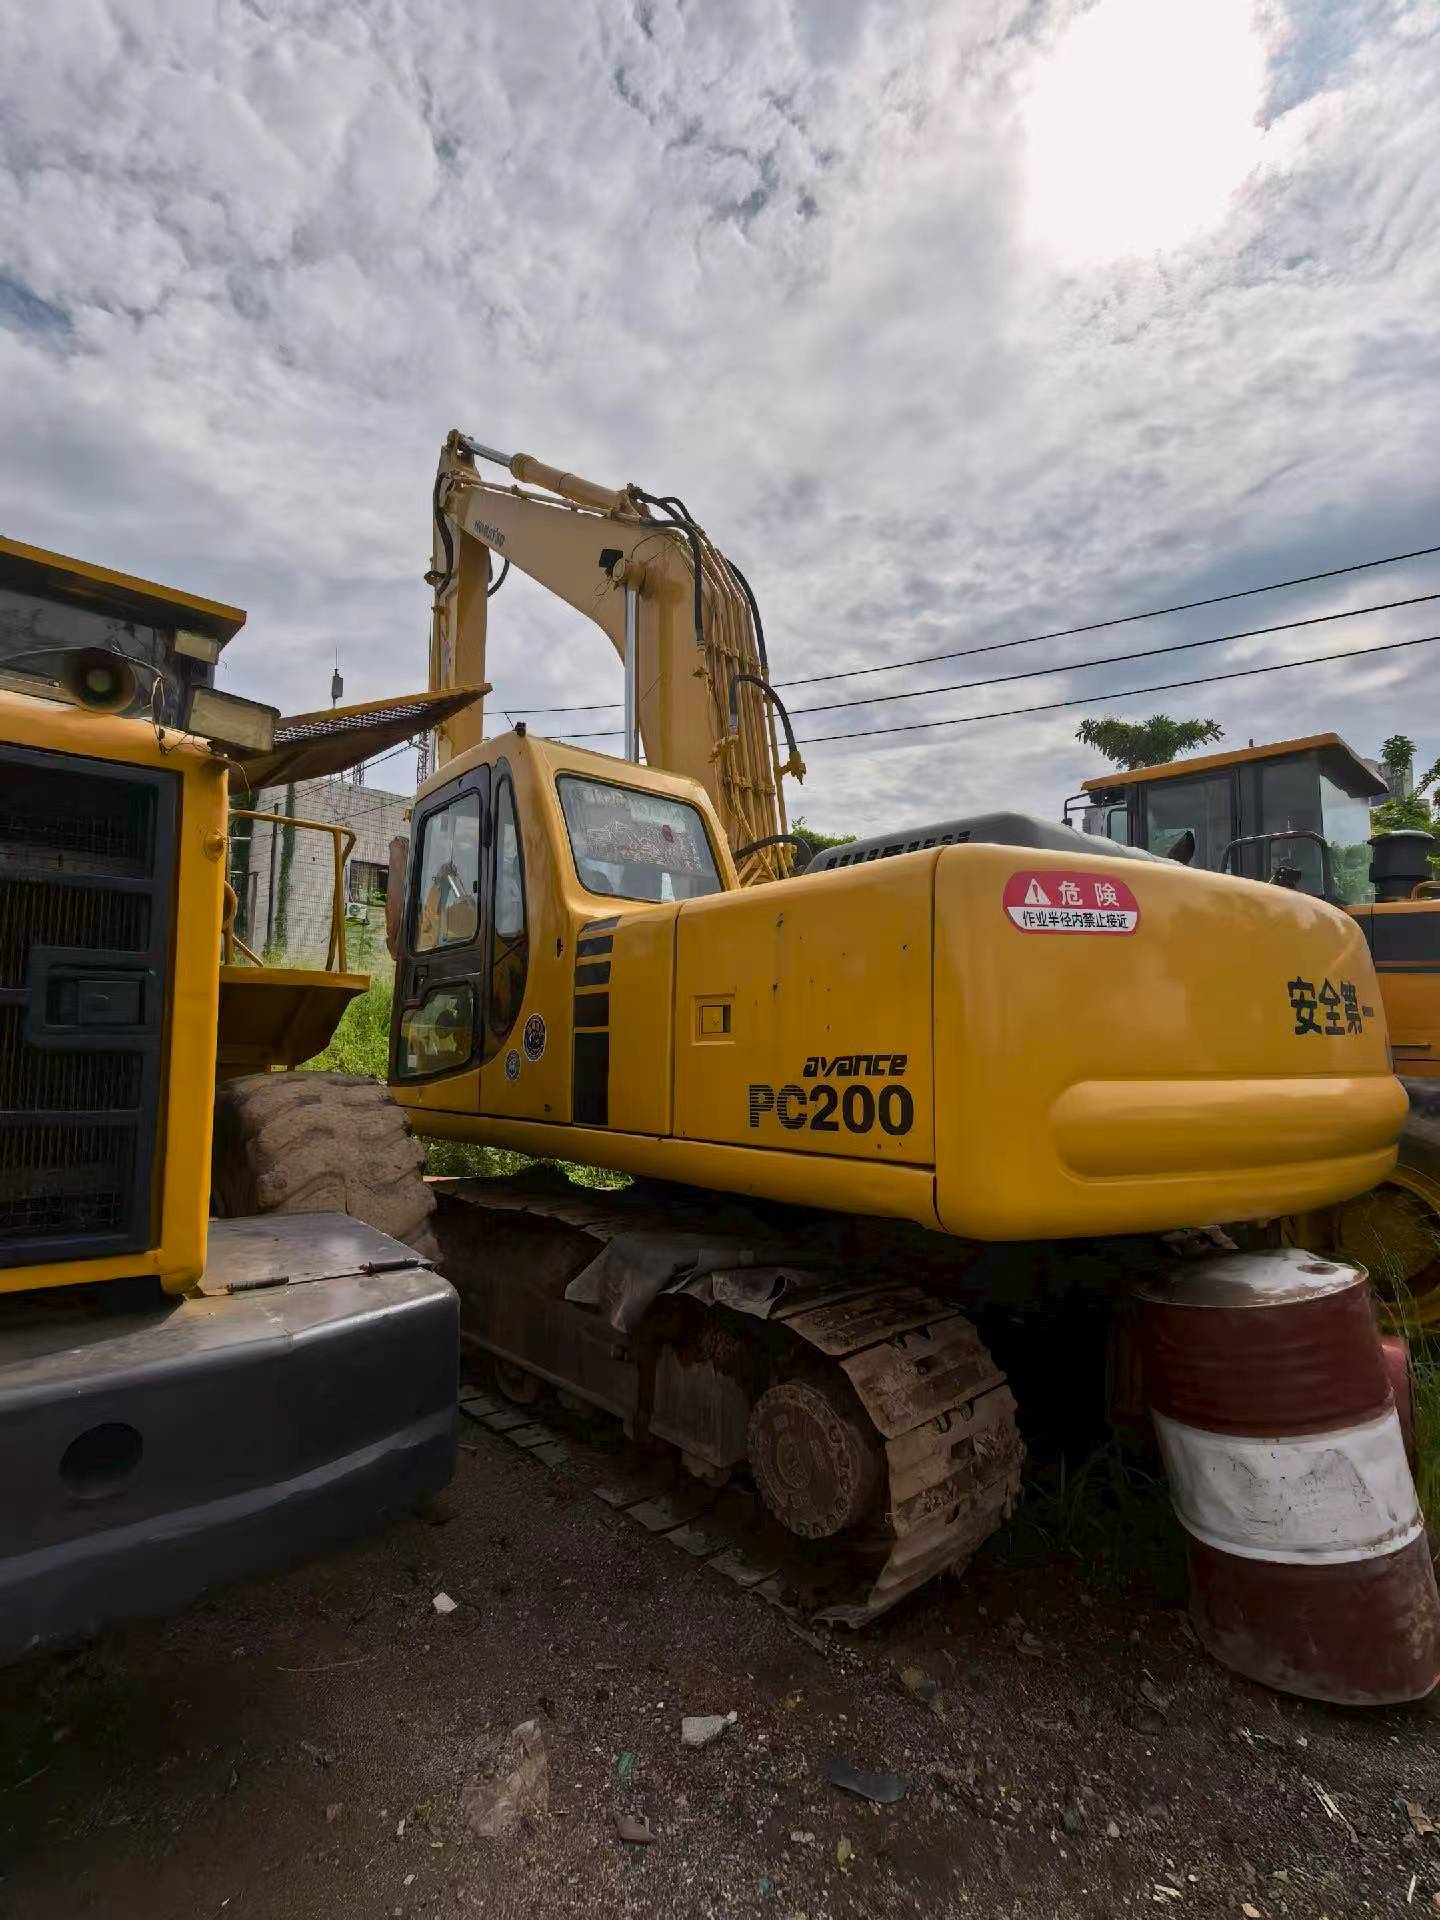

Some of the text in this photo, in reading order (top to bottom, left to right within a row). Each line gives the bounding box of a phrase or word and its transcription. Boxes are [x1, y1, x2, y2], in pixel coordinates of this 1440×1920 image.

[1022, 910, 1129, 929] 作业半径内禁止接近
[802, 1054, 908, 1078] avance
[749, 1084, 914, 1136] PC200
